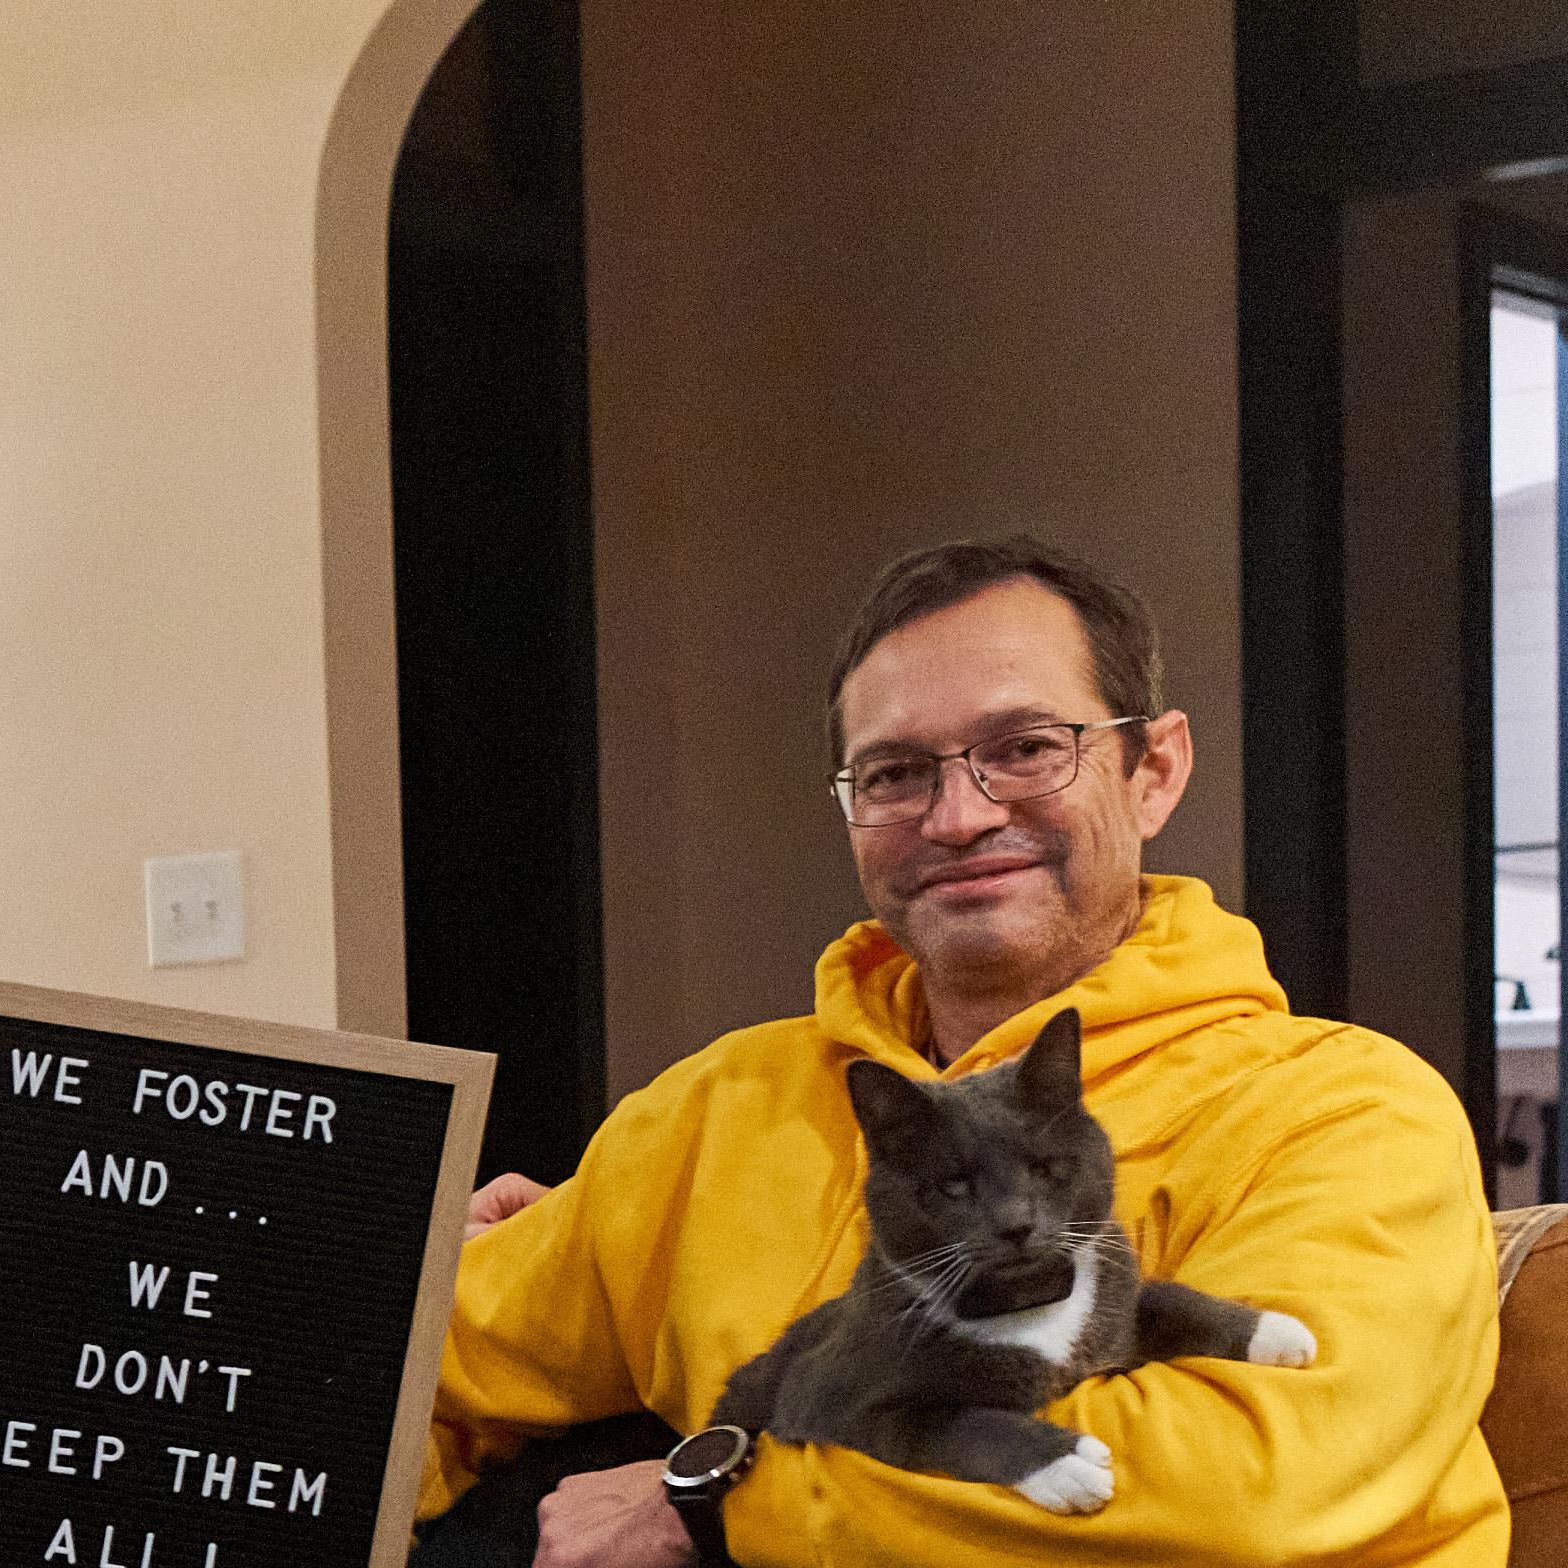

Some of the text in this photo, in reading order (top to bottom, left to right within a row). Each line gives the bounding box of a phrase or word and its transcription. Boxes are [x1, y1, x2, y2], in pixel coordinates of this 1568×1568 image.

[11, 1048, 337, 1144] WE FOSTER
[129, 1260, 219, 1319] WE
[75, 1343, 252, 1412] DON'T
[167, 1446, 327, 1516] THEM
